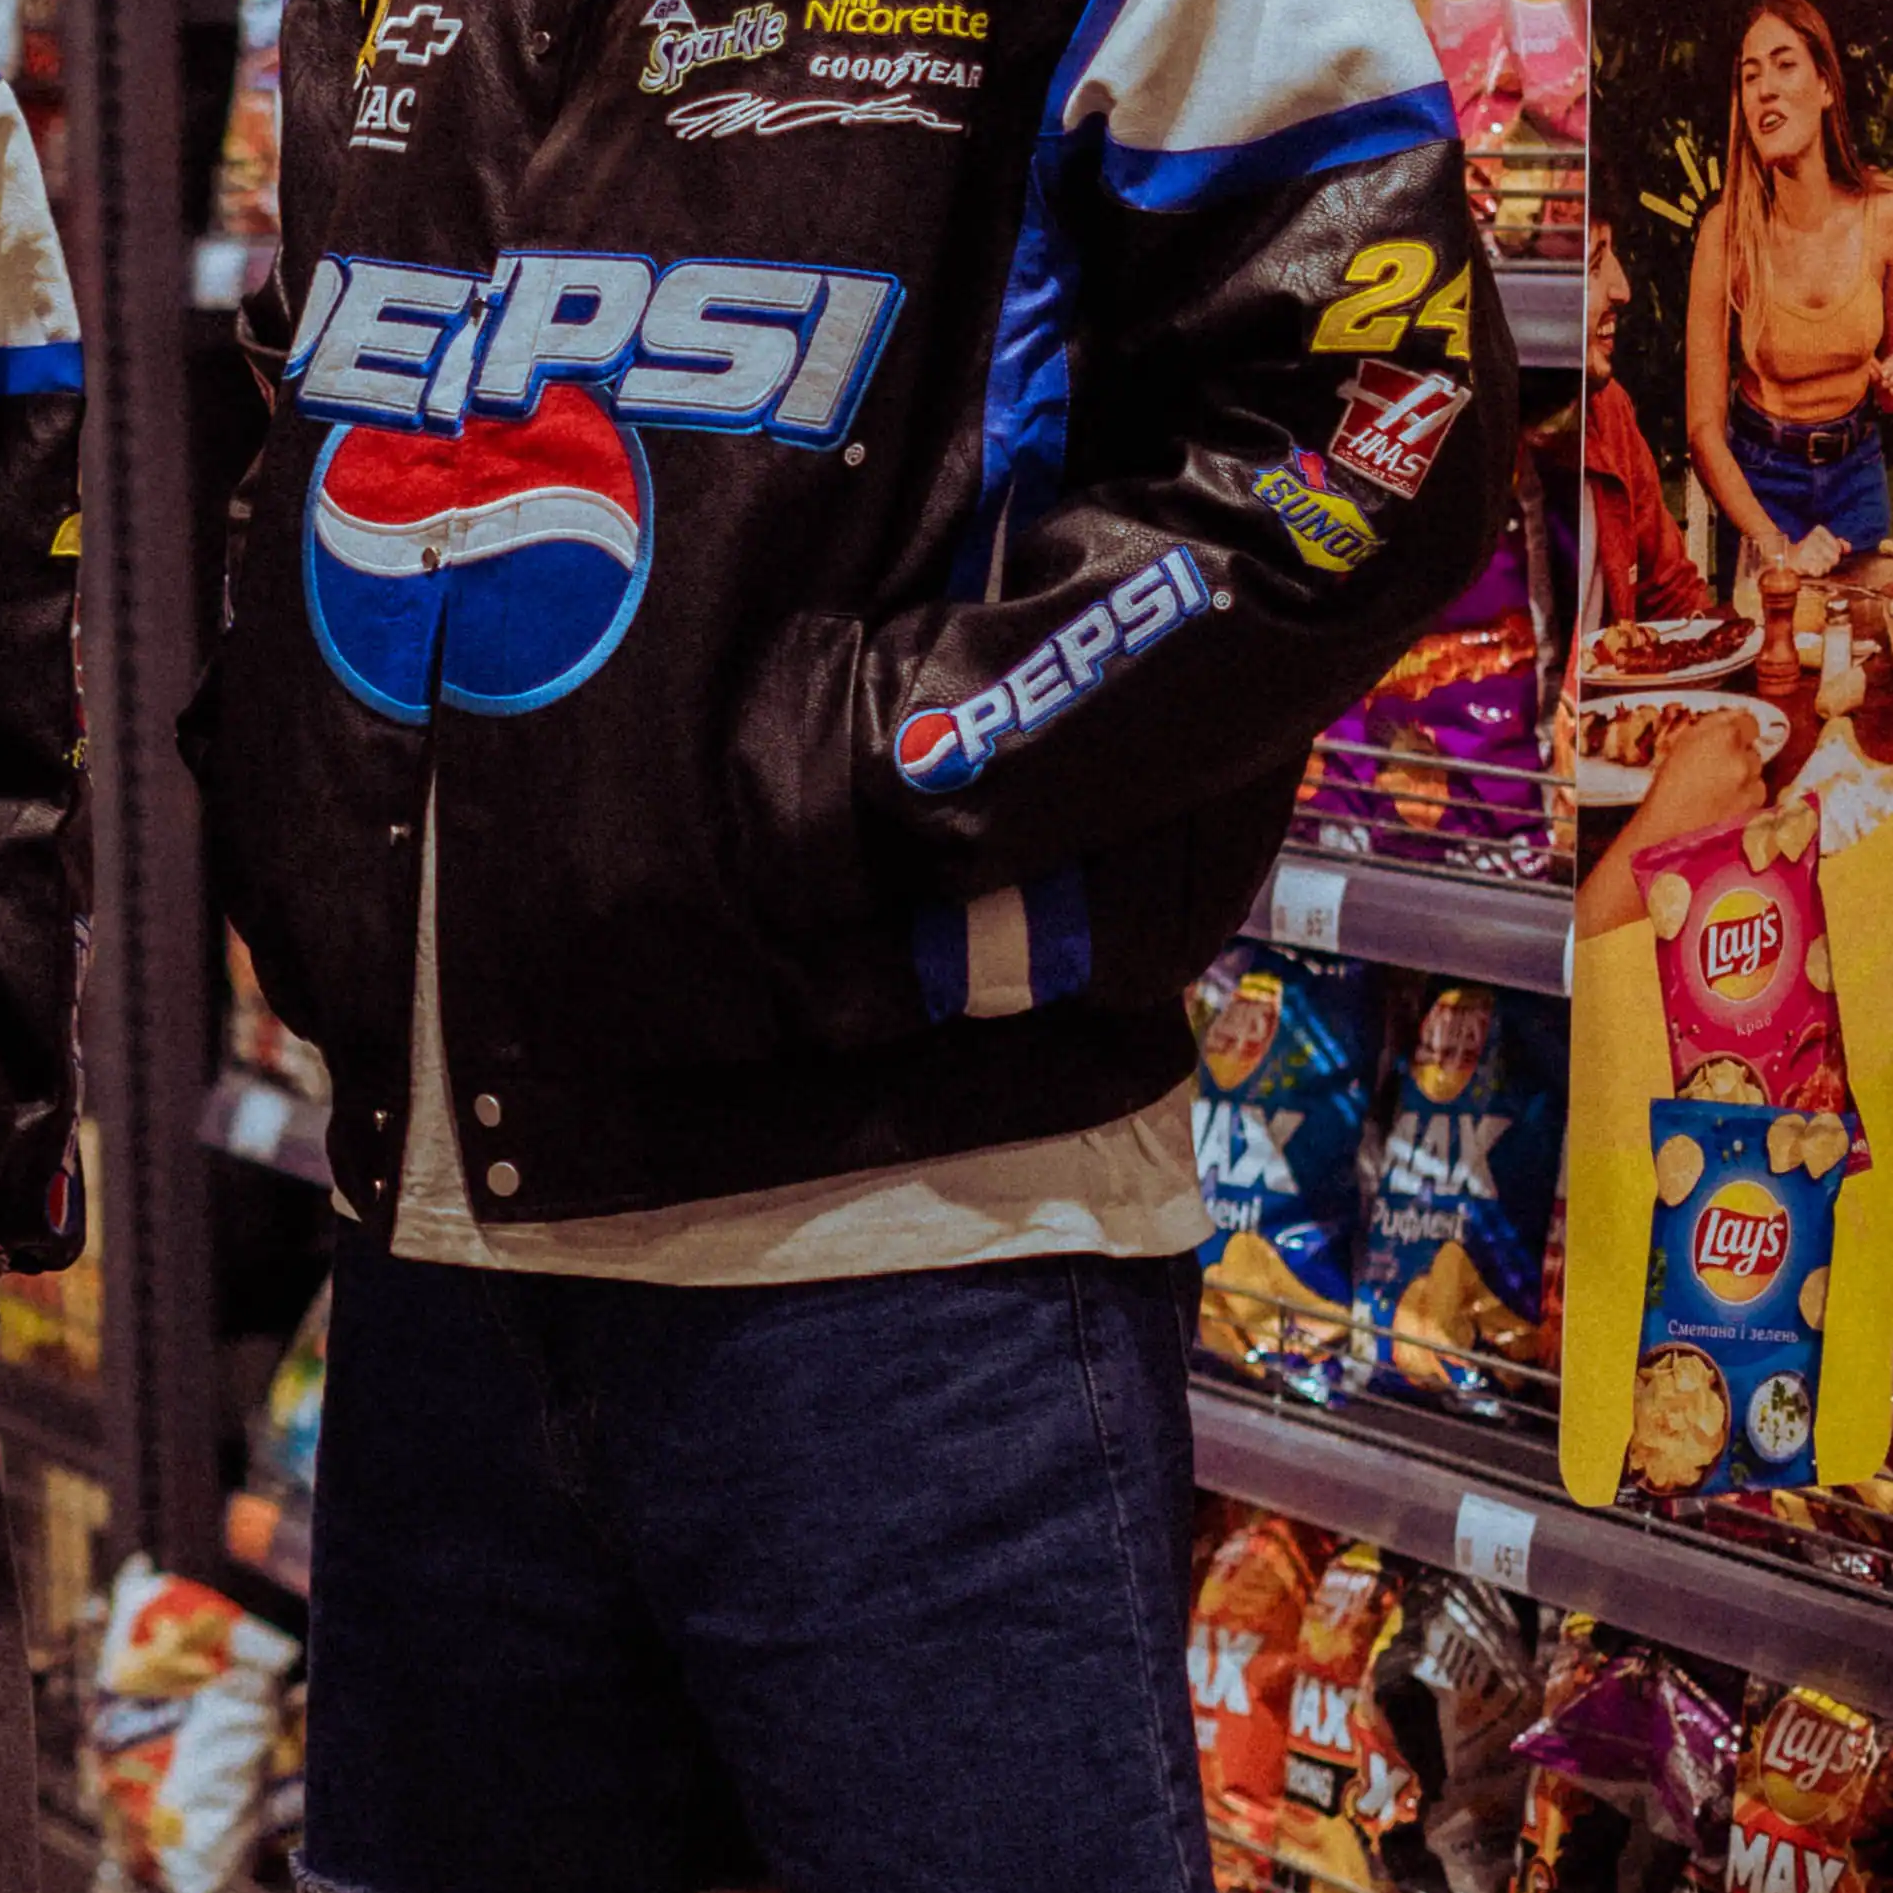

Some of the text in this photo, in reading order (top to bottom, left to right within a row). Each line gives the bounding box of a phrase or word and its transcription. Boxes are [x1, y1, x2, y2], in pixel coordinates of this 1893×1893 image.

[639, 4, 788, 96] Sparkle
[810, 51, 983, 89] GOODYEAR
[1311, 238, 1473, 361] 24
[1347, 426, 1429, 479] HAAS
[950, 545, 1212, 768] PEPSI
[1708, 901, 1779, 979] Lay's
[1698, 1207, 1786, 1277] Lay's
[1667, 1318, 1737, 1340] Сметана
[1747, 1326, 1800, 1344] зелень
